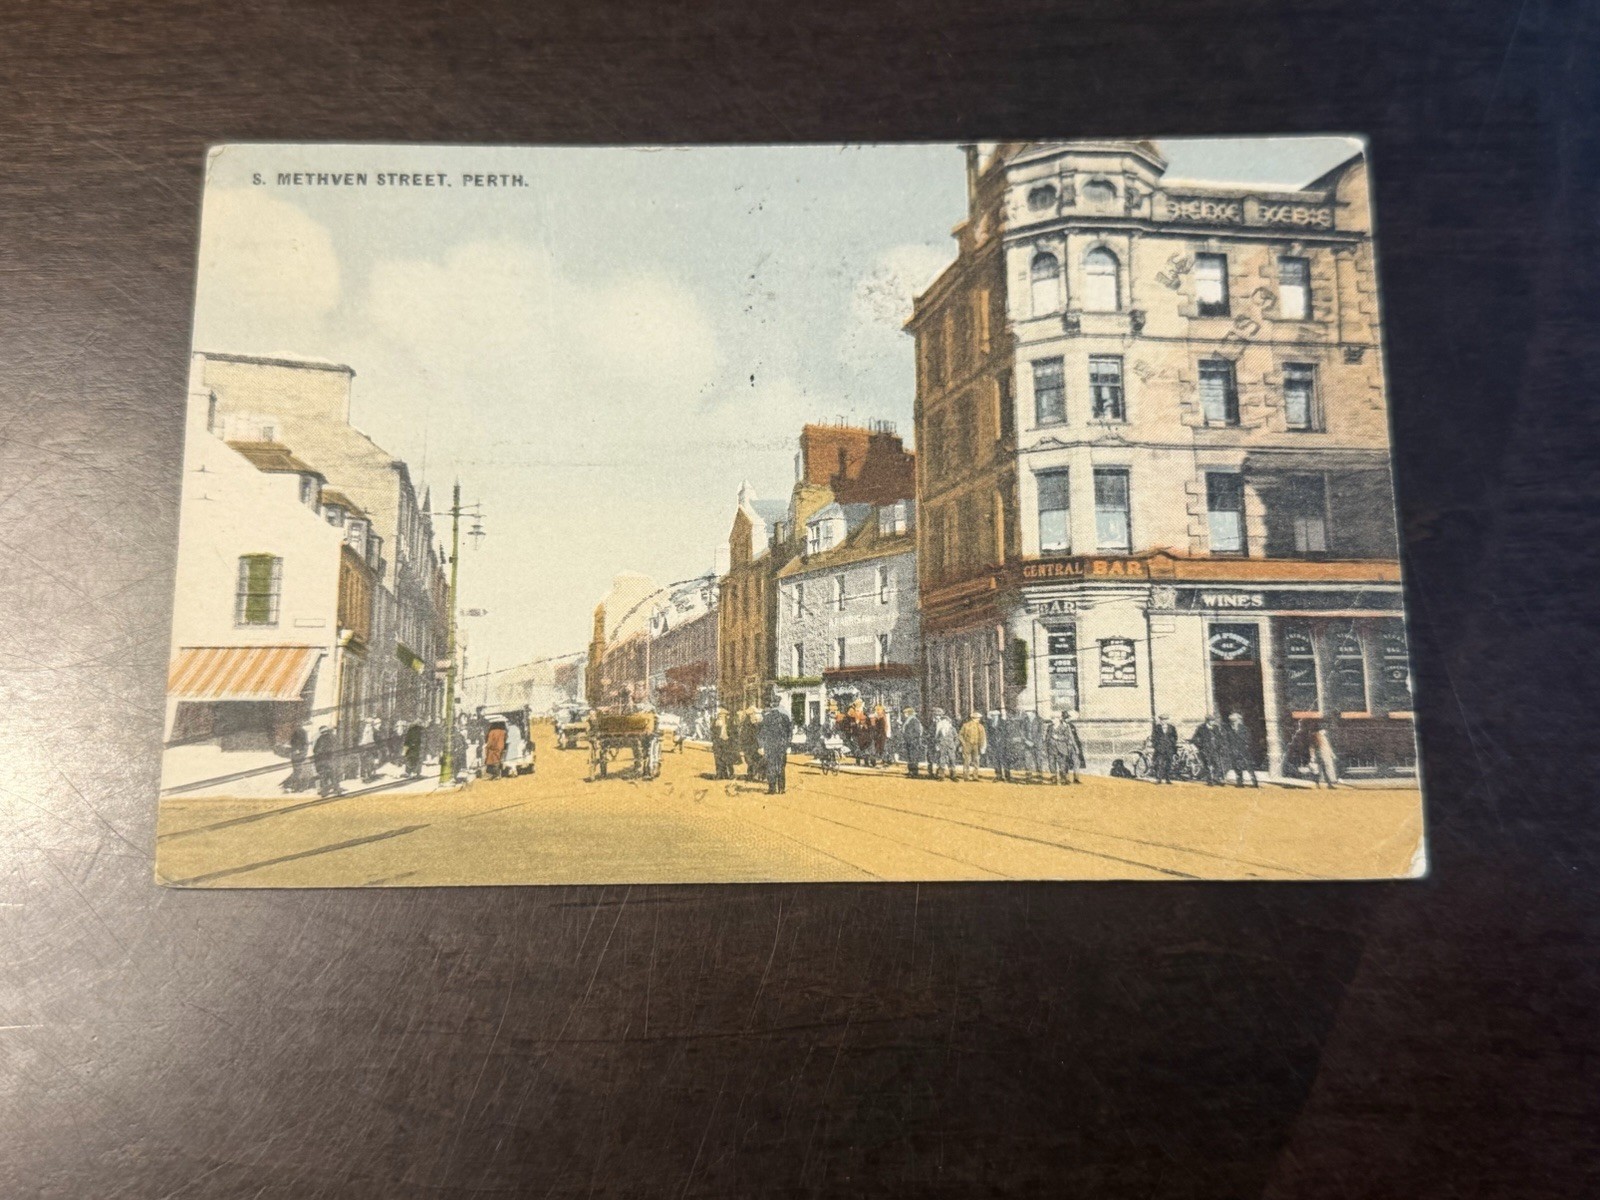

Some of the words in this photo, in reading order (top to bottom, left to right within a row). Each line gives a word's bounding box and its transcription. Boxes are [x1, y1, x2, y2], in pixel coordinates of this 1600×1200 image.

[252, 172, 266, 186] S.
[277, 172, 367, 186] METHVEN
[463, 174, 529, 187] PERTH.
[1023, 562, 1082, 577] CENTRAL
[1093, 560, 1143, 575] BAR
[1201, 594, 1262, 608] WINES
